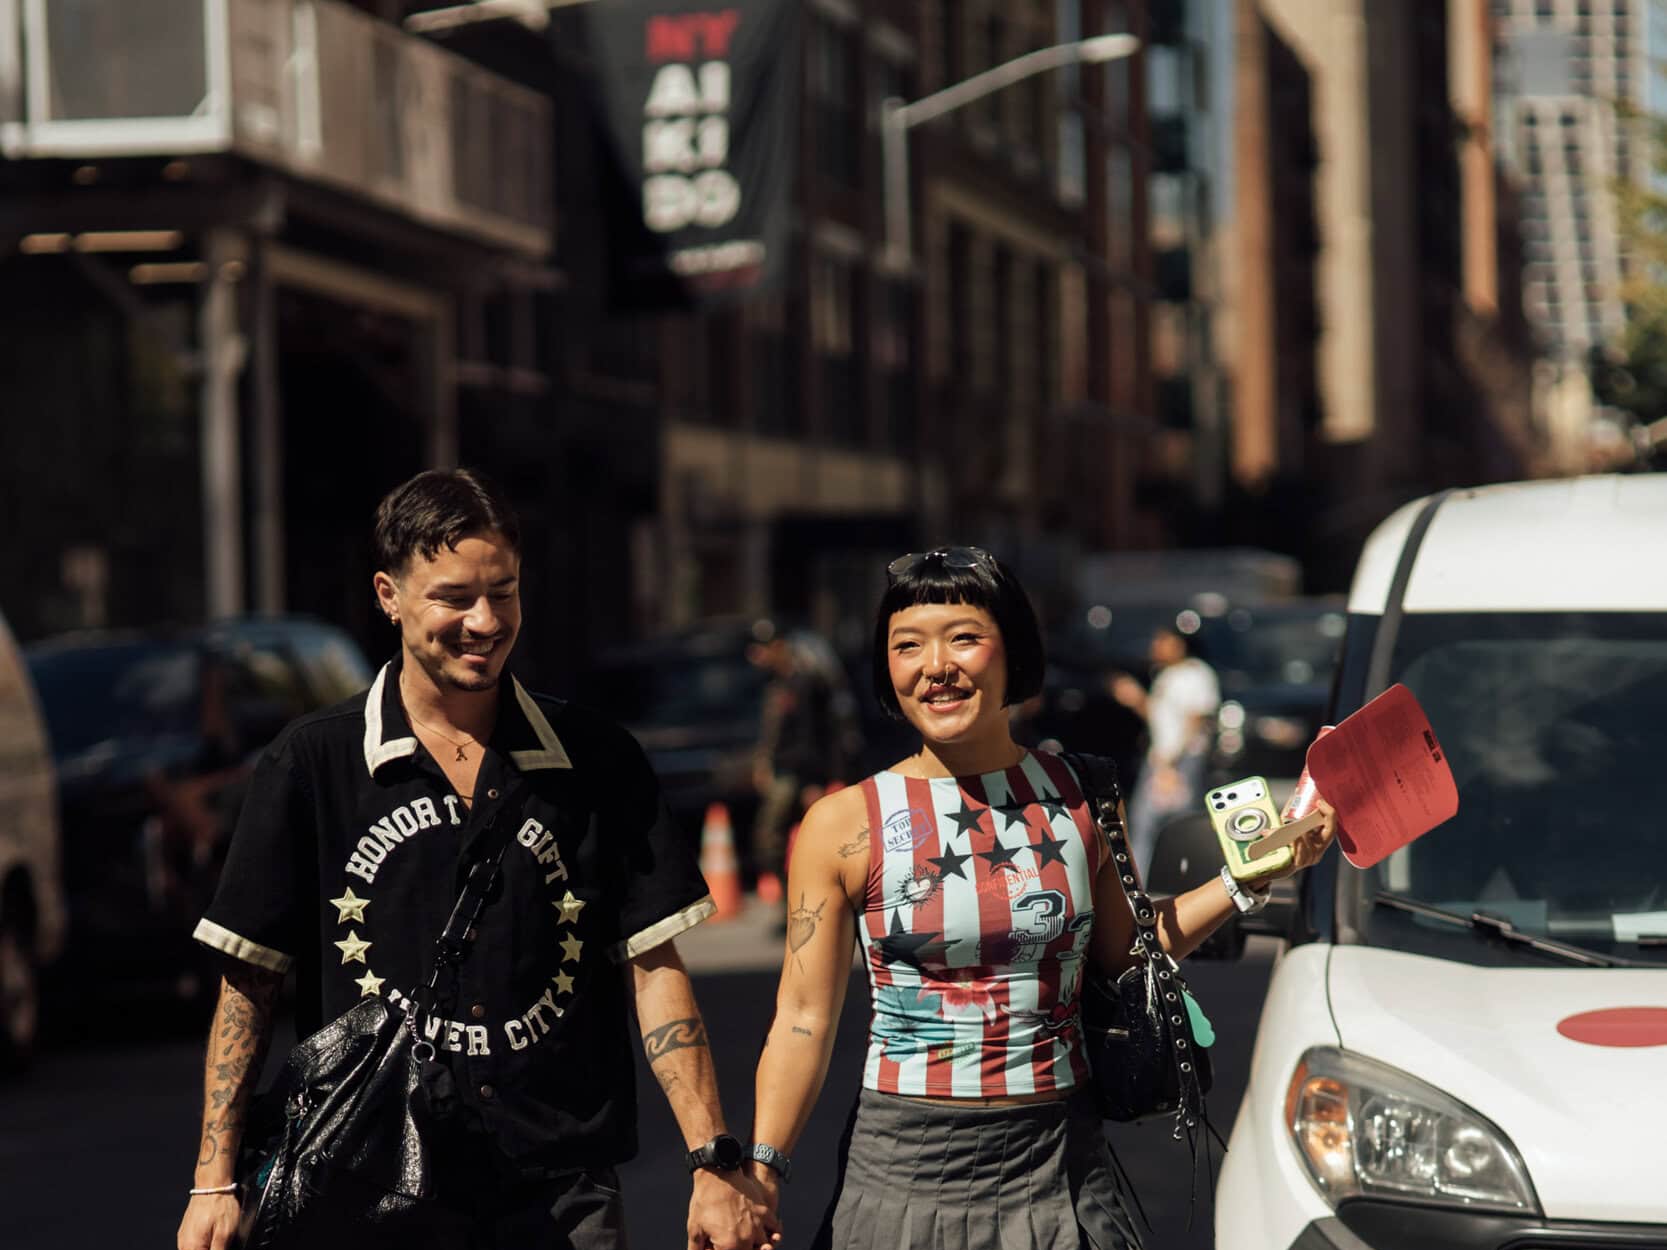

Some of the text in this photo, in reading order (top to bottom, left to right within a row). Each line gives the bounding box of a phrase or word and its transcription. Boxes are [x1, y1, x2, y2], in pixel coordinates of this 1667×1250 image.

[345, 796, 442, 884] HONOR
[516, 818, 569, 884] GIFT
[504, 988, 565, 1050] CITY
